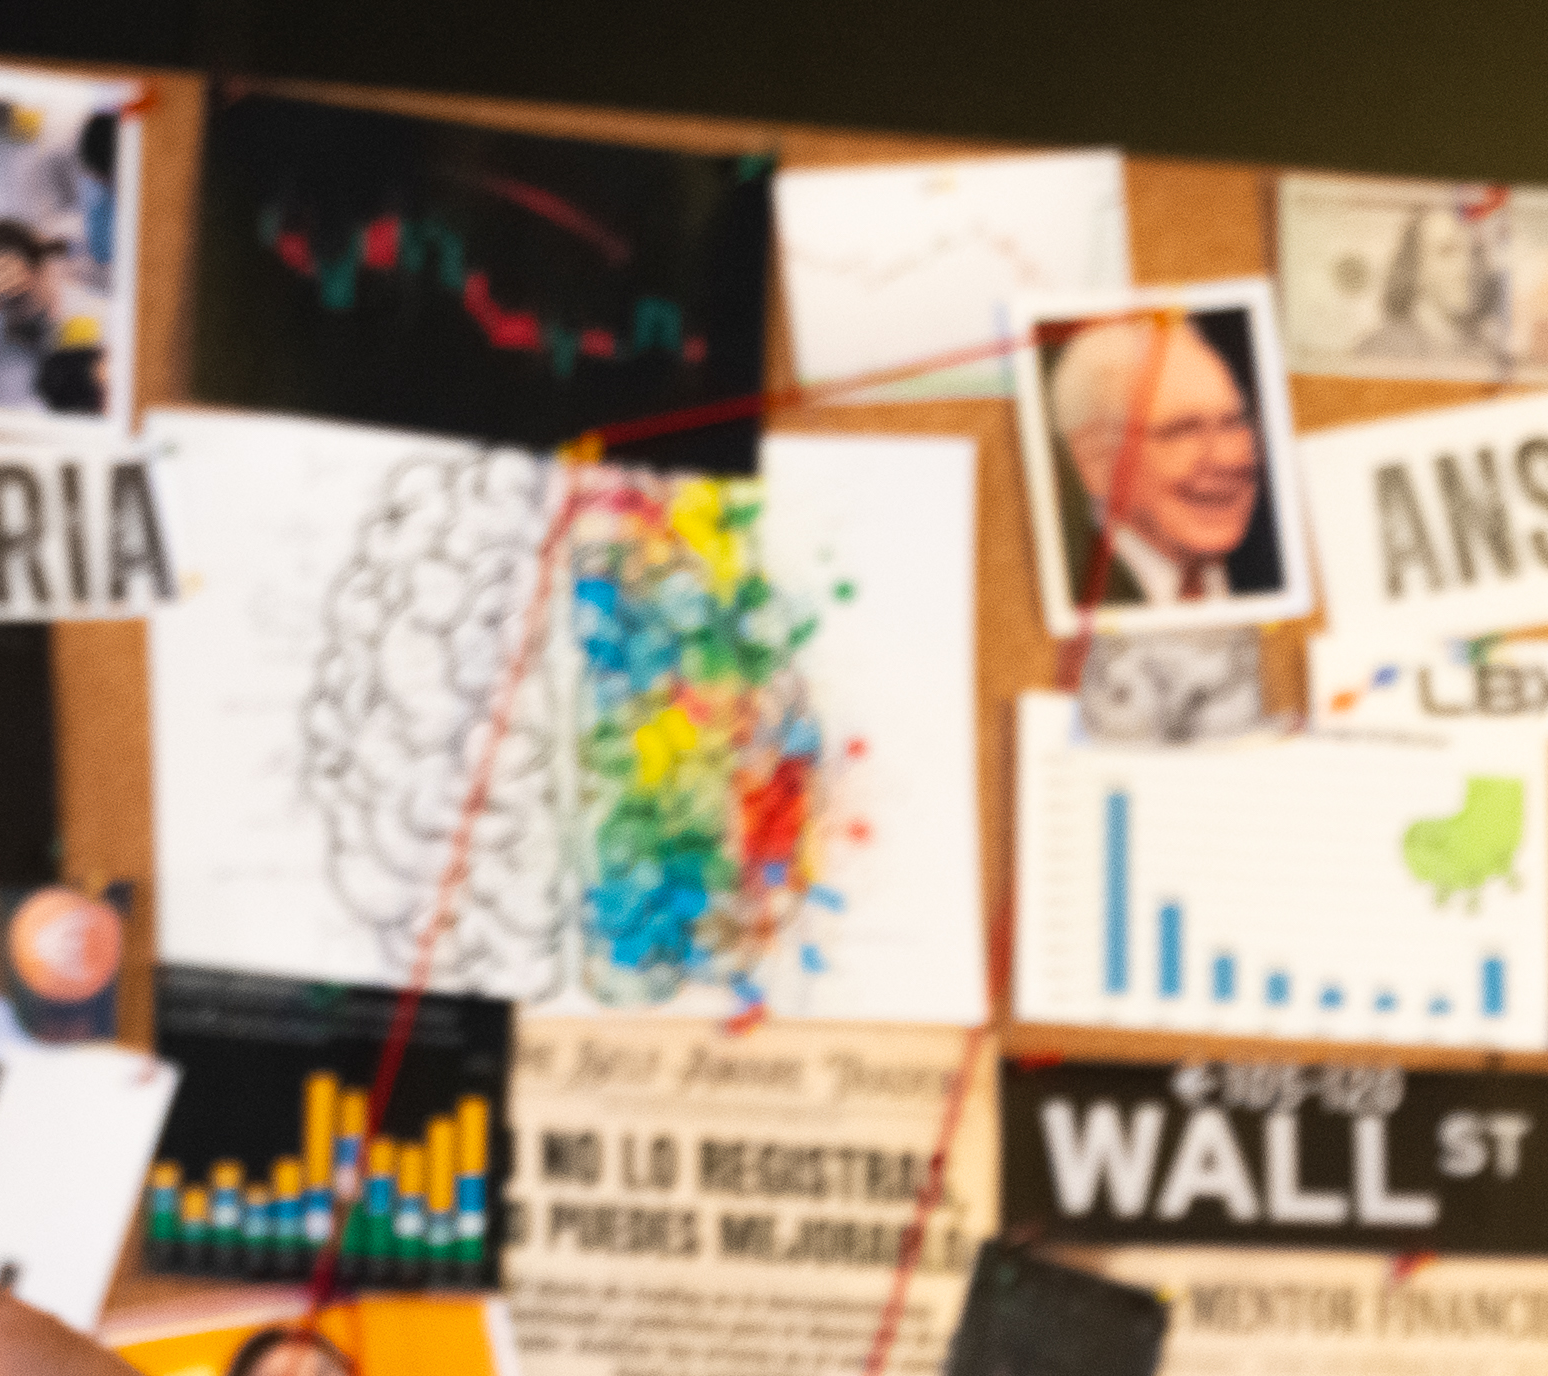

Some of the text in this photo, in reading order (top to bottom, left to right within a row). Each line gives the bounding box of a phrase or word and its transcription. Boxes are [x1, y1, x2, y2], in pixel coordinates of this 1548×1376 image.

[541, 1129, 603, 1186] NO
[622, 1135, 678, 1192] LO
[1040, 1097, 1535, 1229] WALL ST
[550, 1202, 701, 1260] PUEDES
[1190, 1284, 1358, 1337] MENTOR
